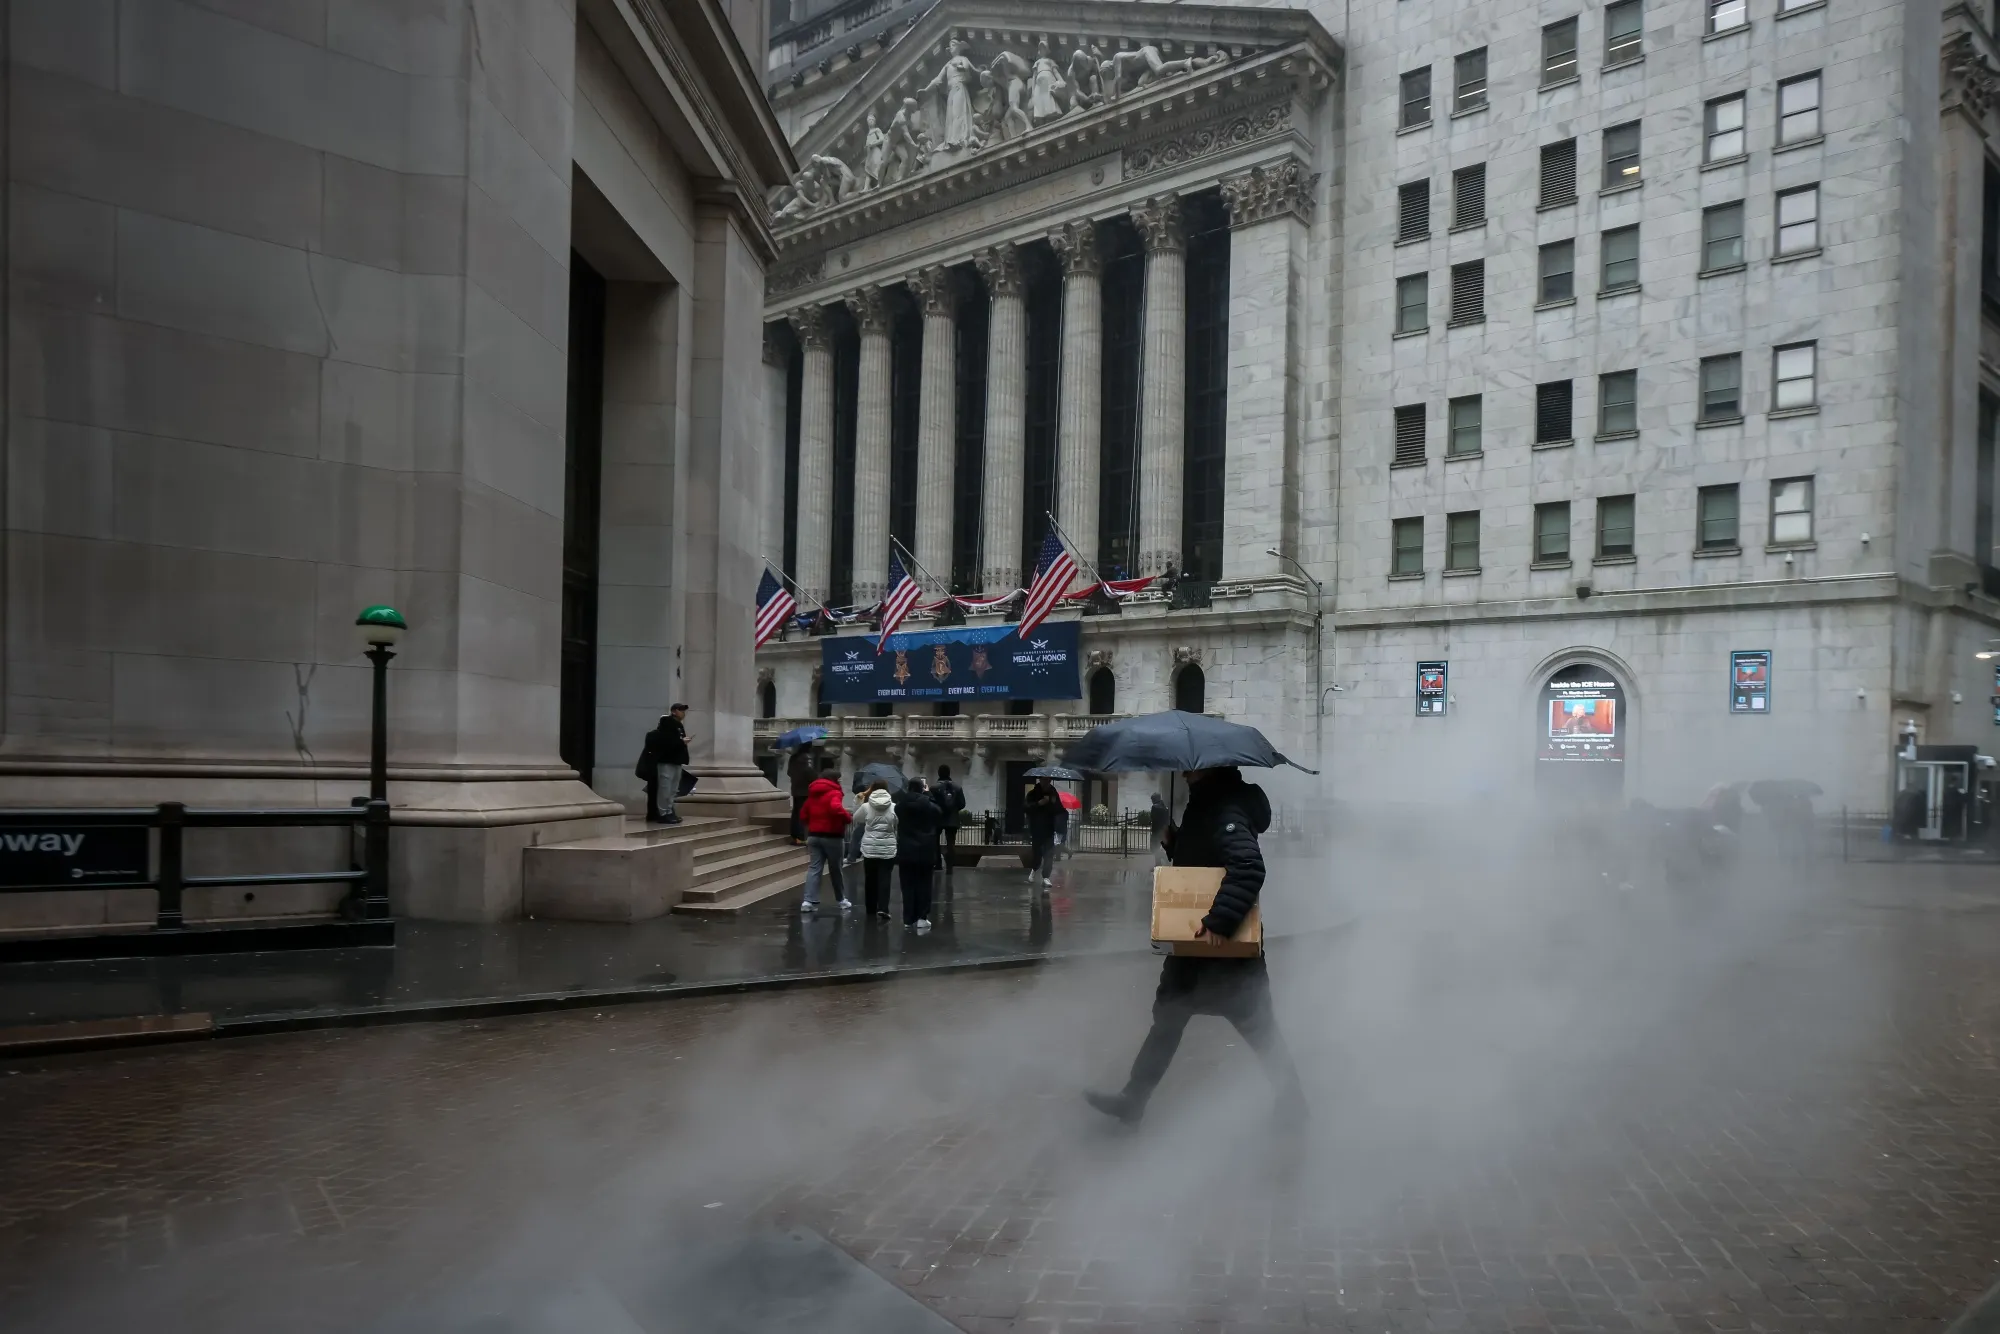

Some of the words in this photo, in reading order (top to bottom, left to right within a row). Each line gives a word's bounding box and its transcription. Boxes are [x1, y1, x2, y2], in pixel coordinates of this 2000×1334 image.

[1012, 655, 1035, 663] MEDAL
[1042, 653, 1067, 662] HONOR
[854, 663, 874, 671] HONOR
[948, 687, 962, 695] EVERY
[962, 686, 975, 694] RACE
